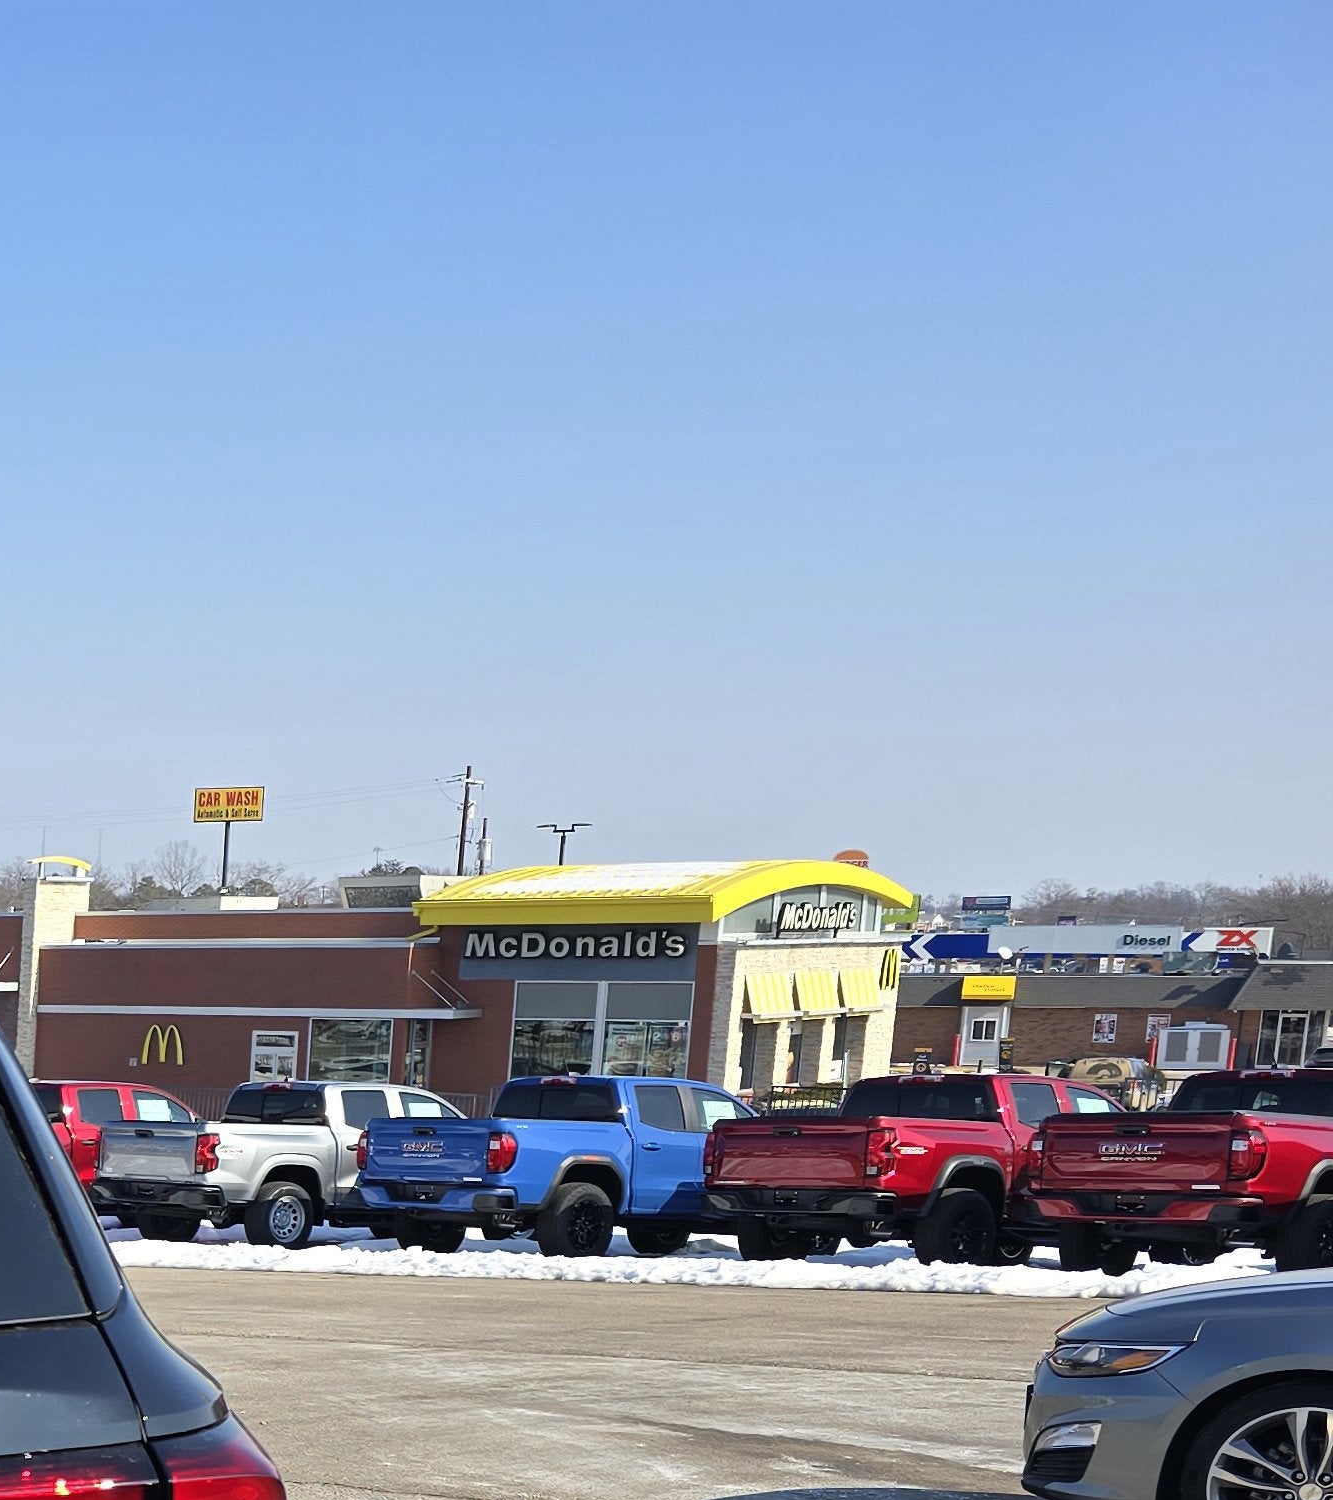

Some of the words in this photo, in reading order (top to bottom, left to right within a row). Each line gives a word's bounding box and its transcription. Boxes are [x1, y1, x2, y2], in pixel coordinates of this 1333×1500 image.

[199, 792, 221, 807] CAR
[226, 791, 259, 807] WASH
[780, 903, 857, 930] McDonald's
[464, 931, 685, 959] McDonald's
[1122, 934, 1172, 947] Diesel
[401, 1141, 444, 1152] GMC
[1099, 1143, 1163, 1155] GMC
